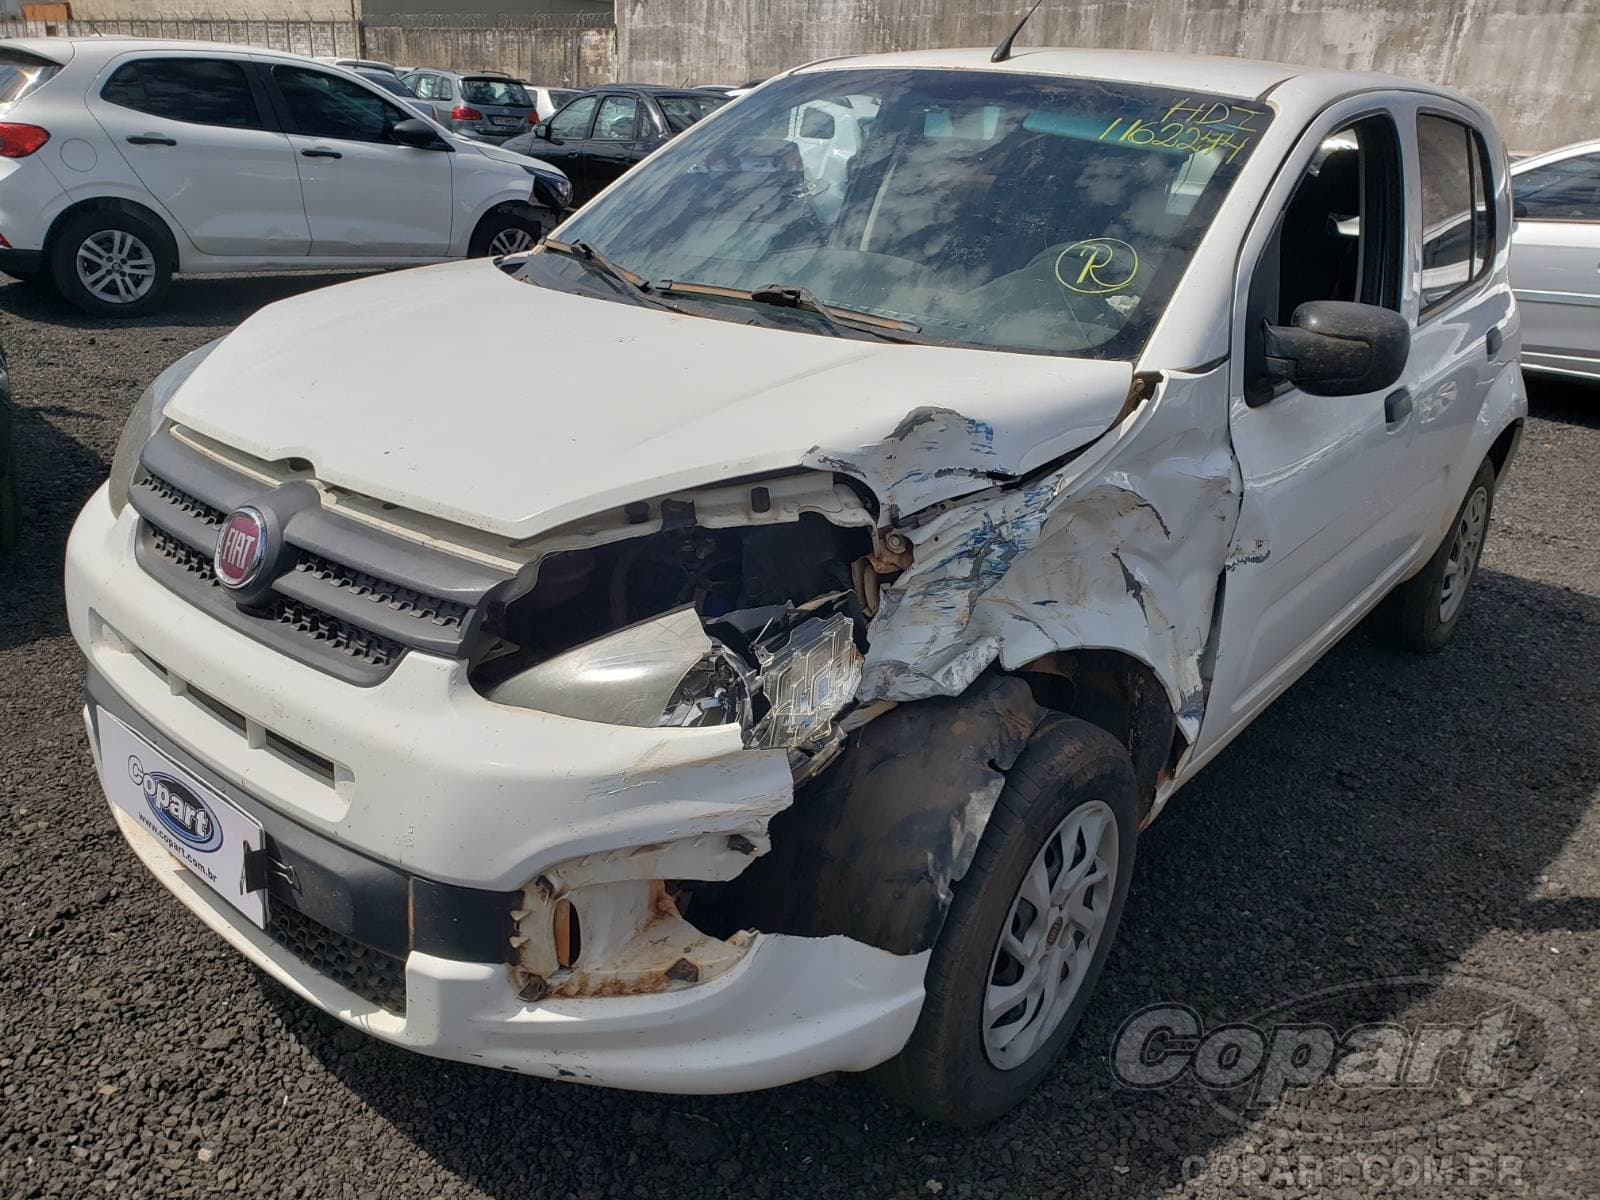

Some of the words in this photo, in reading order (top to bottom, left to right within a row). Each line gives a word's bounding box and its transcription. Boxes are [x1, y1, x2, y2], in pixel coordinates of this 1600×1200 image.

[222, 526, 257, 570] FIAT
[127, 754, 209, 838] Copart
[138, 810, 218, 884] www.copart.com.br
